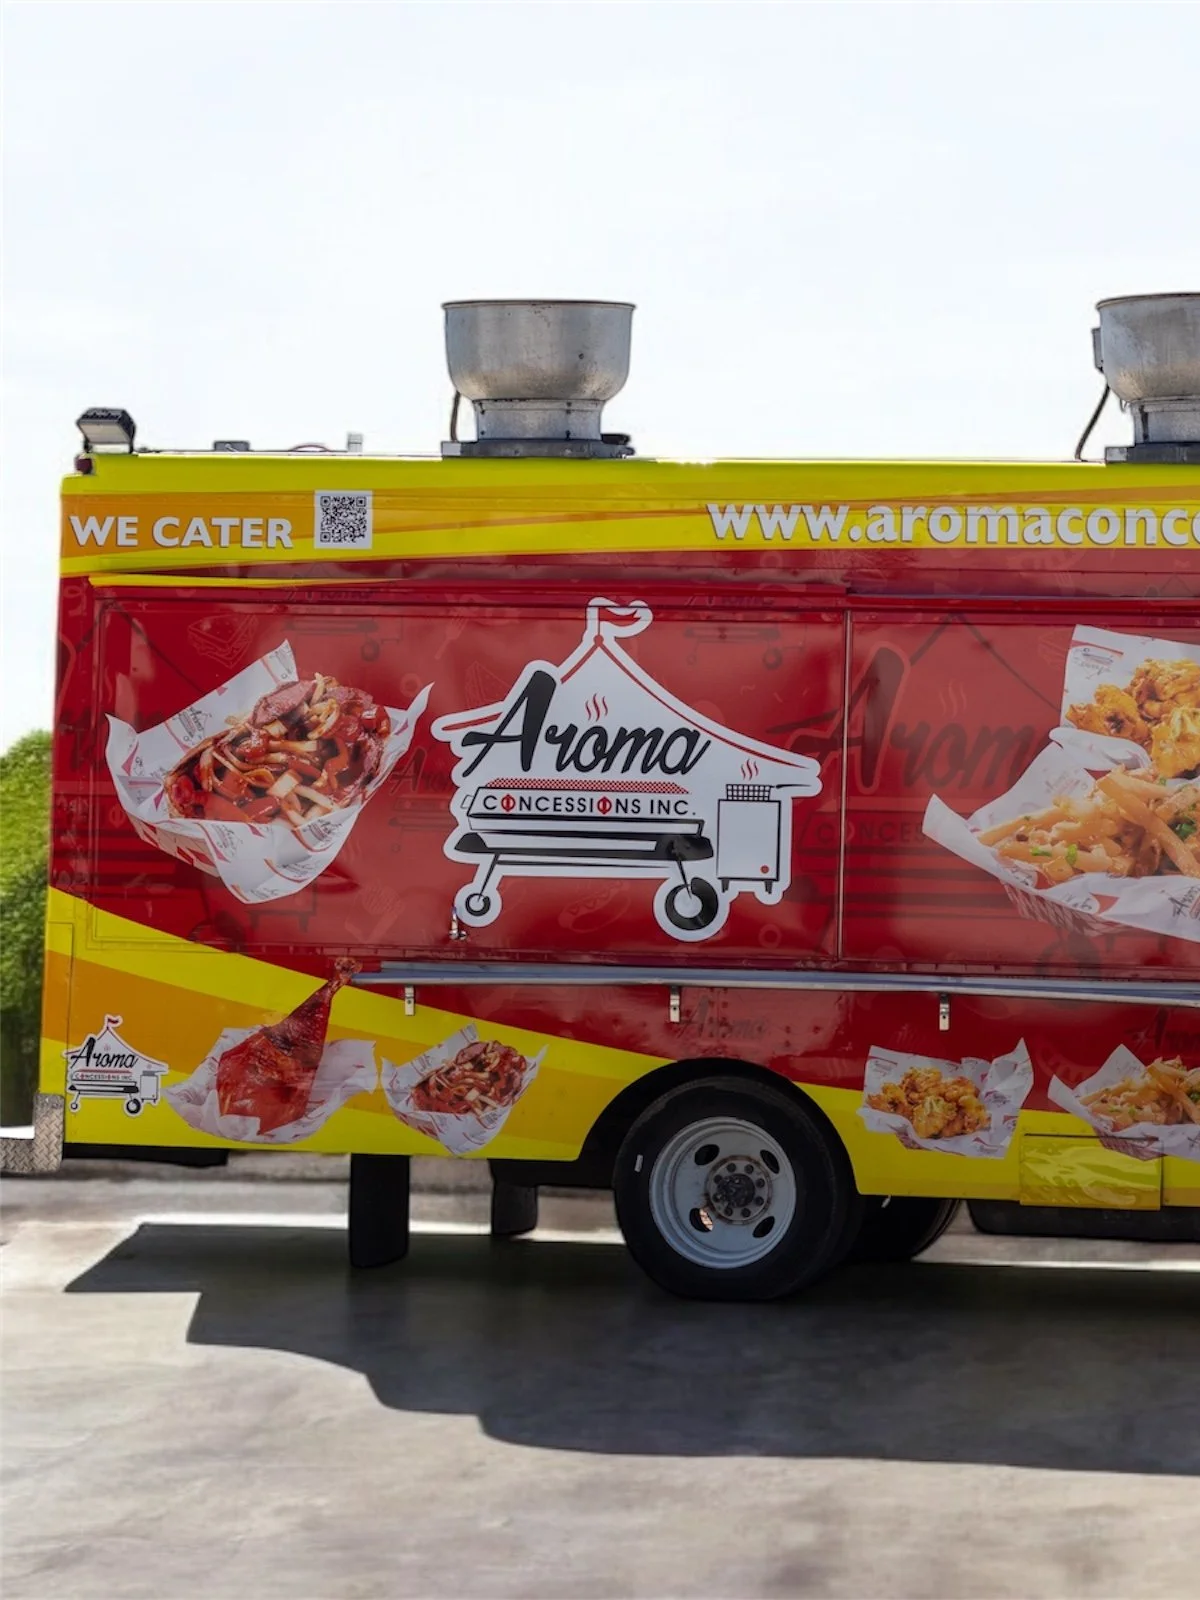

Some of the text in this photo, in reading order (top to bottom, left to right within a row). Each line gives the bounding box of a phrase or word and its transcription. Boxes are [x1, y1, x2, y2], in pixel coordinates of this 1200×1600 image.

[69, 516, 294, 548] WE CATER
[462, 670, 712, 778] Aroma
[791, 646, 1036, 792] Arom
[483, 793, 697, 816] CONCESSIONS INC.
[70, 1037, 139, 1069] Aroma
